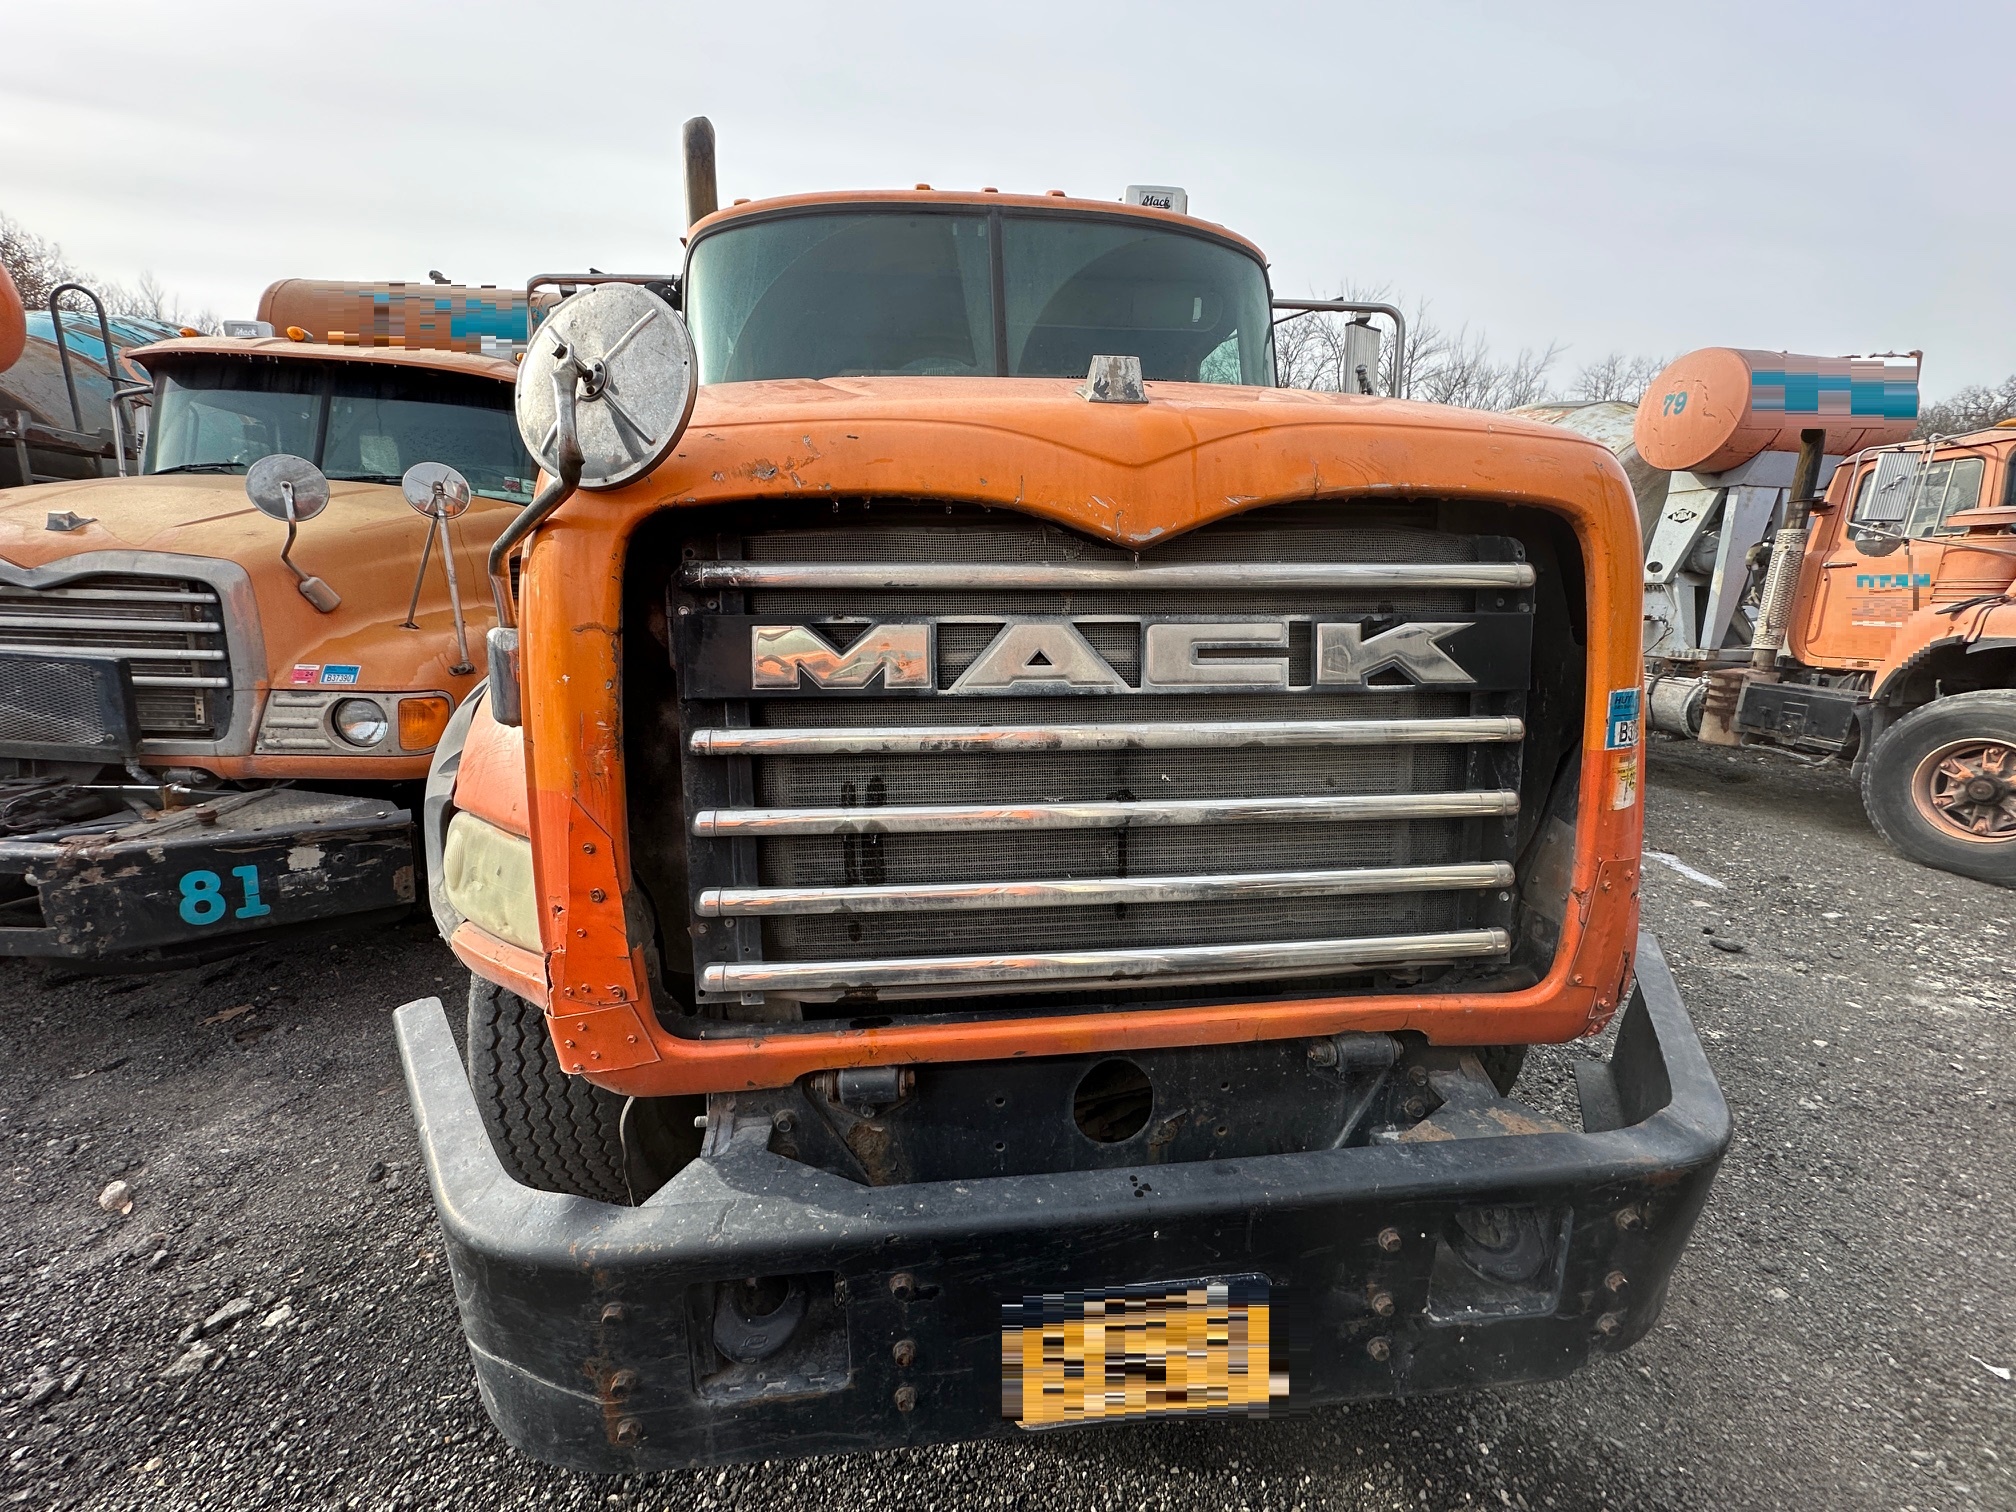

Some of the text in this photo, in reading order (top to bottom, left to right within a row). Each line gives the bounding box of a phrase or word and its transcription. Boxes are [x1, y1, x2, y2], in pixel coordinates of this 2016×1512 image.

[1142, 195, 1171, 209] Mack
[1663, 391, 1687, 417] 79
[751, 621, 1477, 690] MACK
[1614, 695, 1632, 704] HUT
[179, 864, 271, 926] 81
